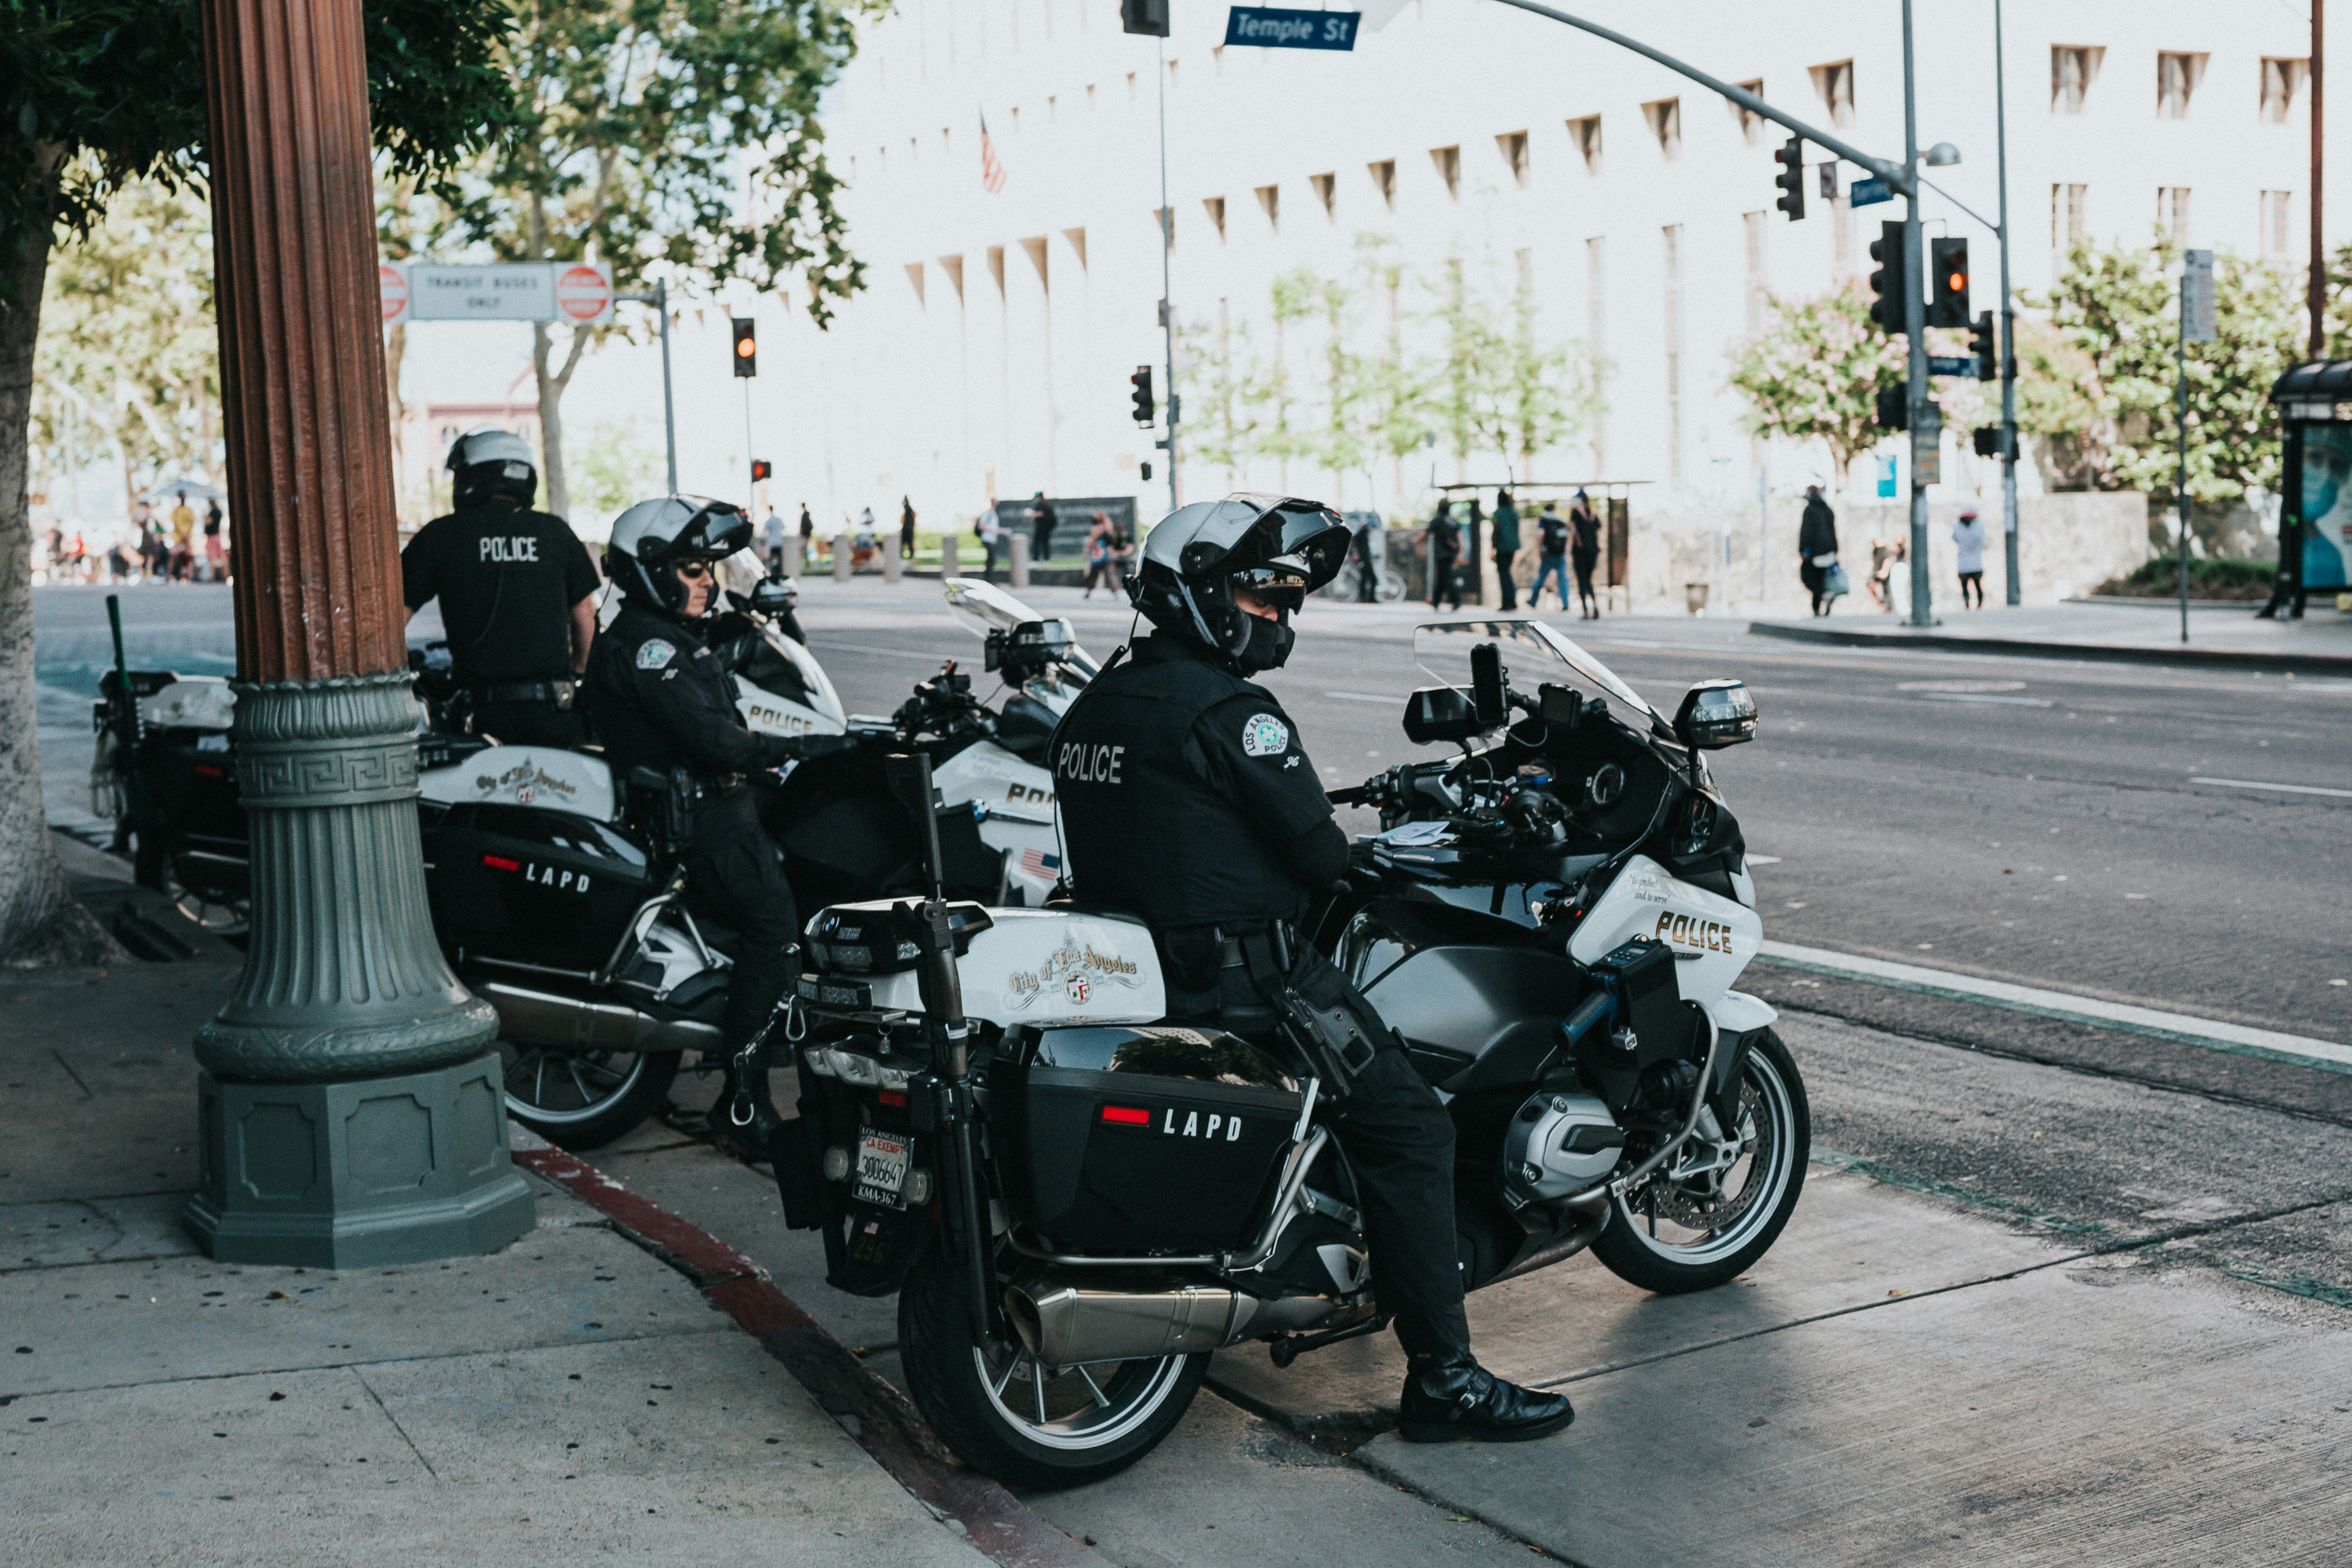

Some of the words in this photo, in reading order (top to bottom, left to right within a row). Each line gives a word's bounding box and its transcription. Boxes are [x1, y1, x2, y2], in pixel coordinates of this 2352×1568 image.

[1237, 13, 1314, 43] Temple
[1323, 18, 1349, 41] St
[480, 537, 539, 562] POLICE
[749, 705, 813, 732] POLICE
[1245, 732, 1256, 752] LOS
[1265, 735, 1286, 753] POLICE
[1058, 743, 1124, 783] POLICE
[1006, 783, 1055, 814] POL
[526, 863, 590, 893] LAPD
[1638, 877, 1658, 888] protect
[1635, 890, 1647, 900] and
[1647, 892, 1653, 902] to
[1655, 910, 1732, 954] POLICE
[1009, 972, 1039, 995] City
[1040, 959, 1052, 981] of
[1052, 947, 1081, 971] Los
[1083, 944, 1136, 974] Angeles
[862, 1127, 876, 1136] LOS
[877, 1131, 907, 1144] ANGELES
[1163, 1109, 1242, 1141] LAPD
[867, 1136, 876, 1148] CA
[877, 1140, 904, 1155] EXEMPT
[861, 1155, 903, 1187] 3006647
[858, 1185, 897, 1206] KMA-367
